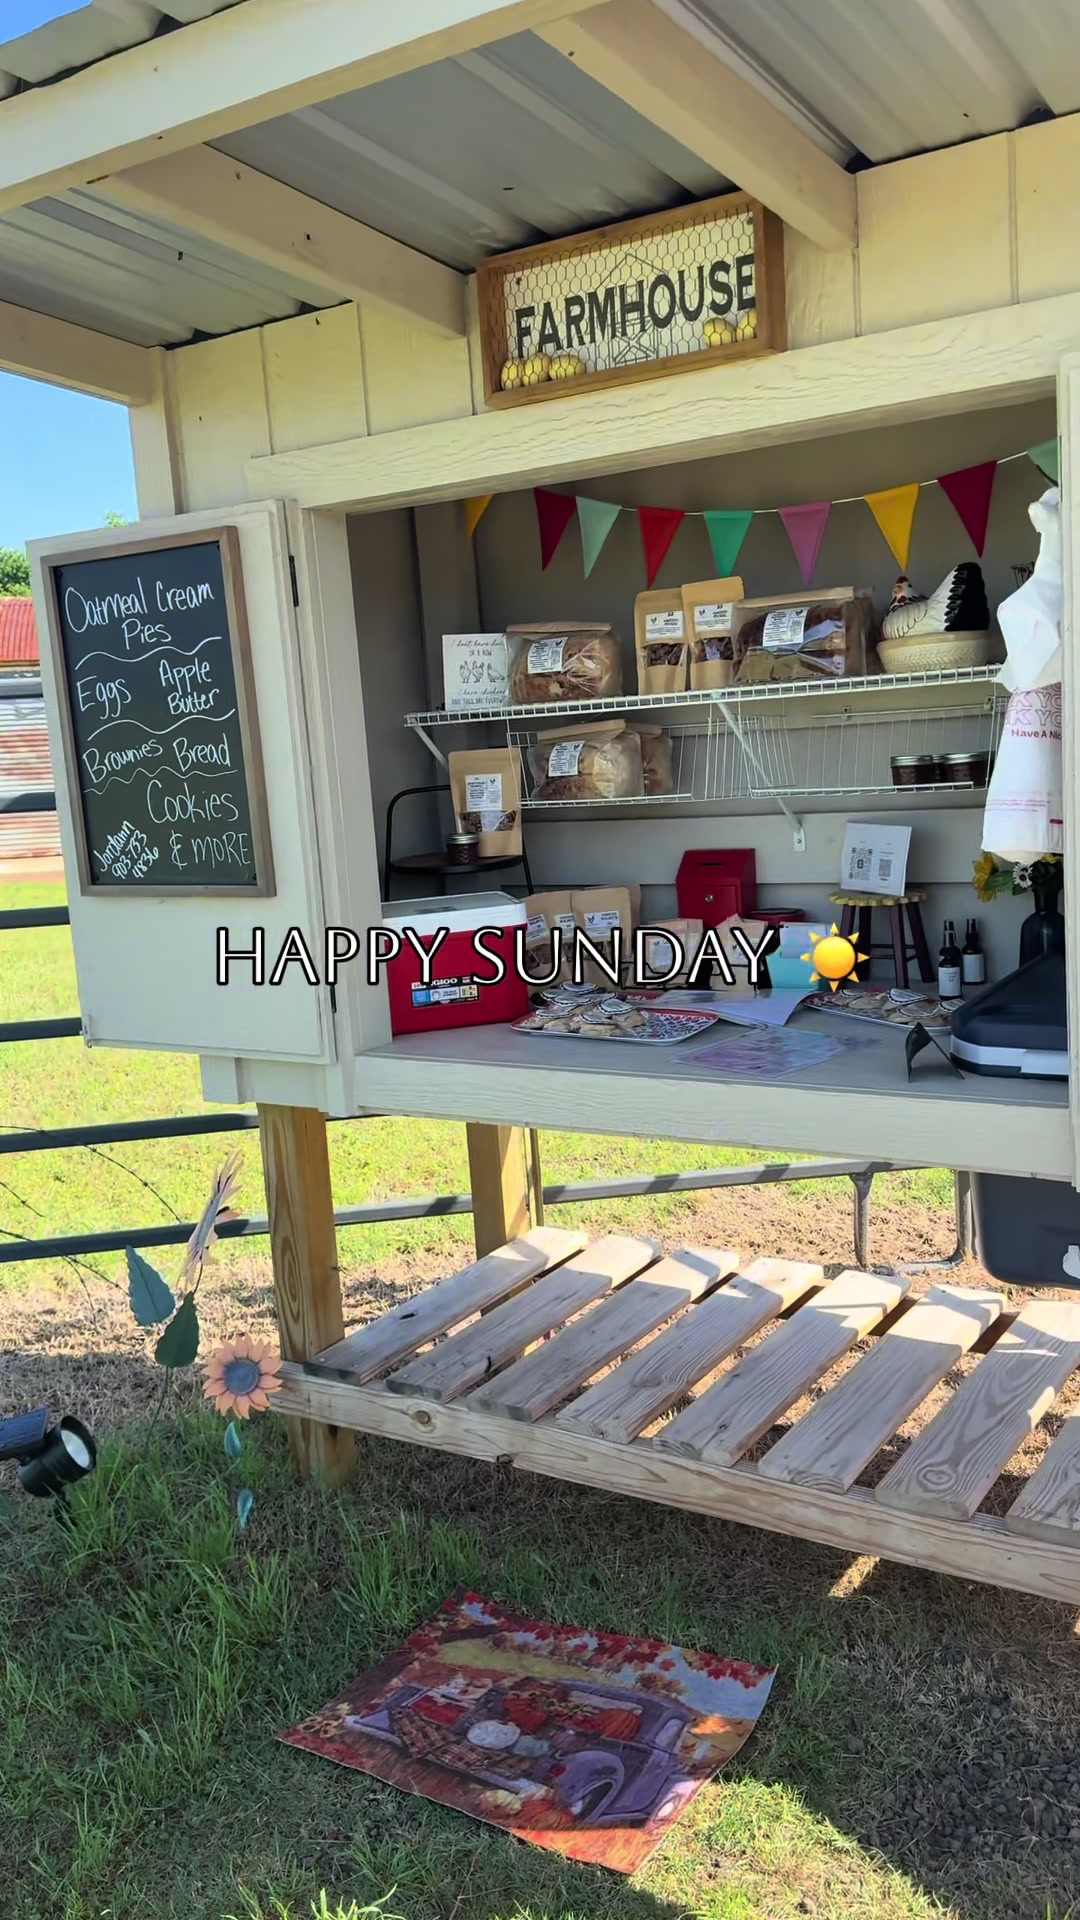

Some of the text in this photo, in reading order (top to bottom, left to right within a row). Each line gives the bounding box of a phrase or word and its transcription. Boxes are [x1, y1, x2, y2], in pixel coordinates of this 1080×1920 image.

[515, 253, 756, 358] FARMHOUSE
[65, 577, 215, 633] Oatmeal Cream
[121, 618, 172, 650] Pies
[76, 675, 132, 719] Eggs
[159, 657, 212, 695] Apple
[168, 688, 219, 715] Butter
[1011, 729, 1062, 740] Have A Nic
[82, 733, 231, 783] Brownies Bread
[147, 779, 239, 824] Cookies
[111, 830, 147, 880] 903-733
[132, 846, 159, 878] 4836
